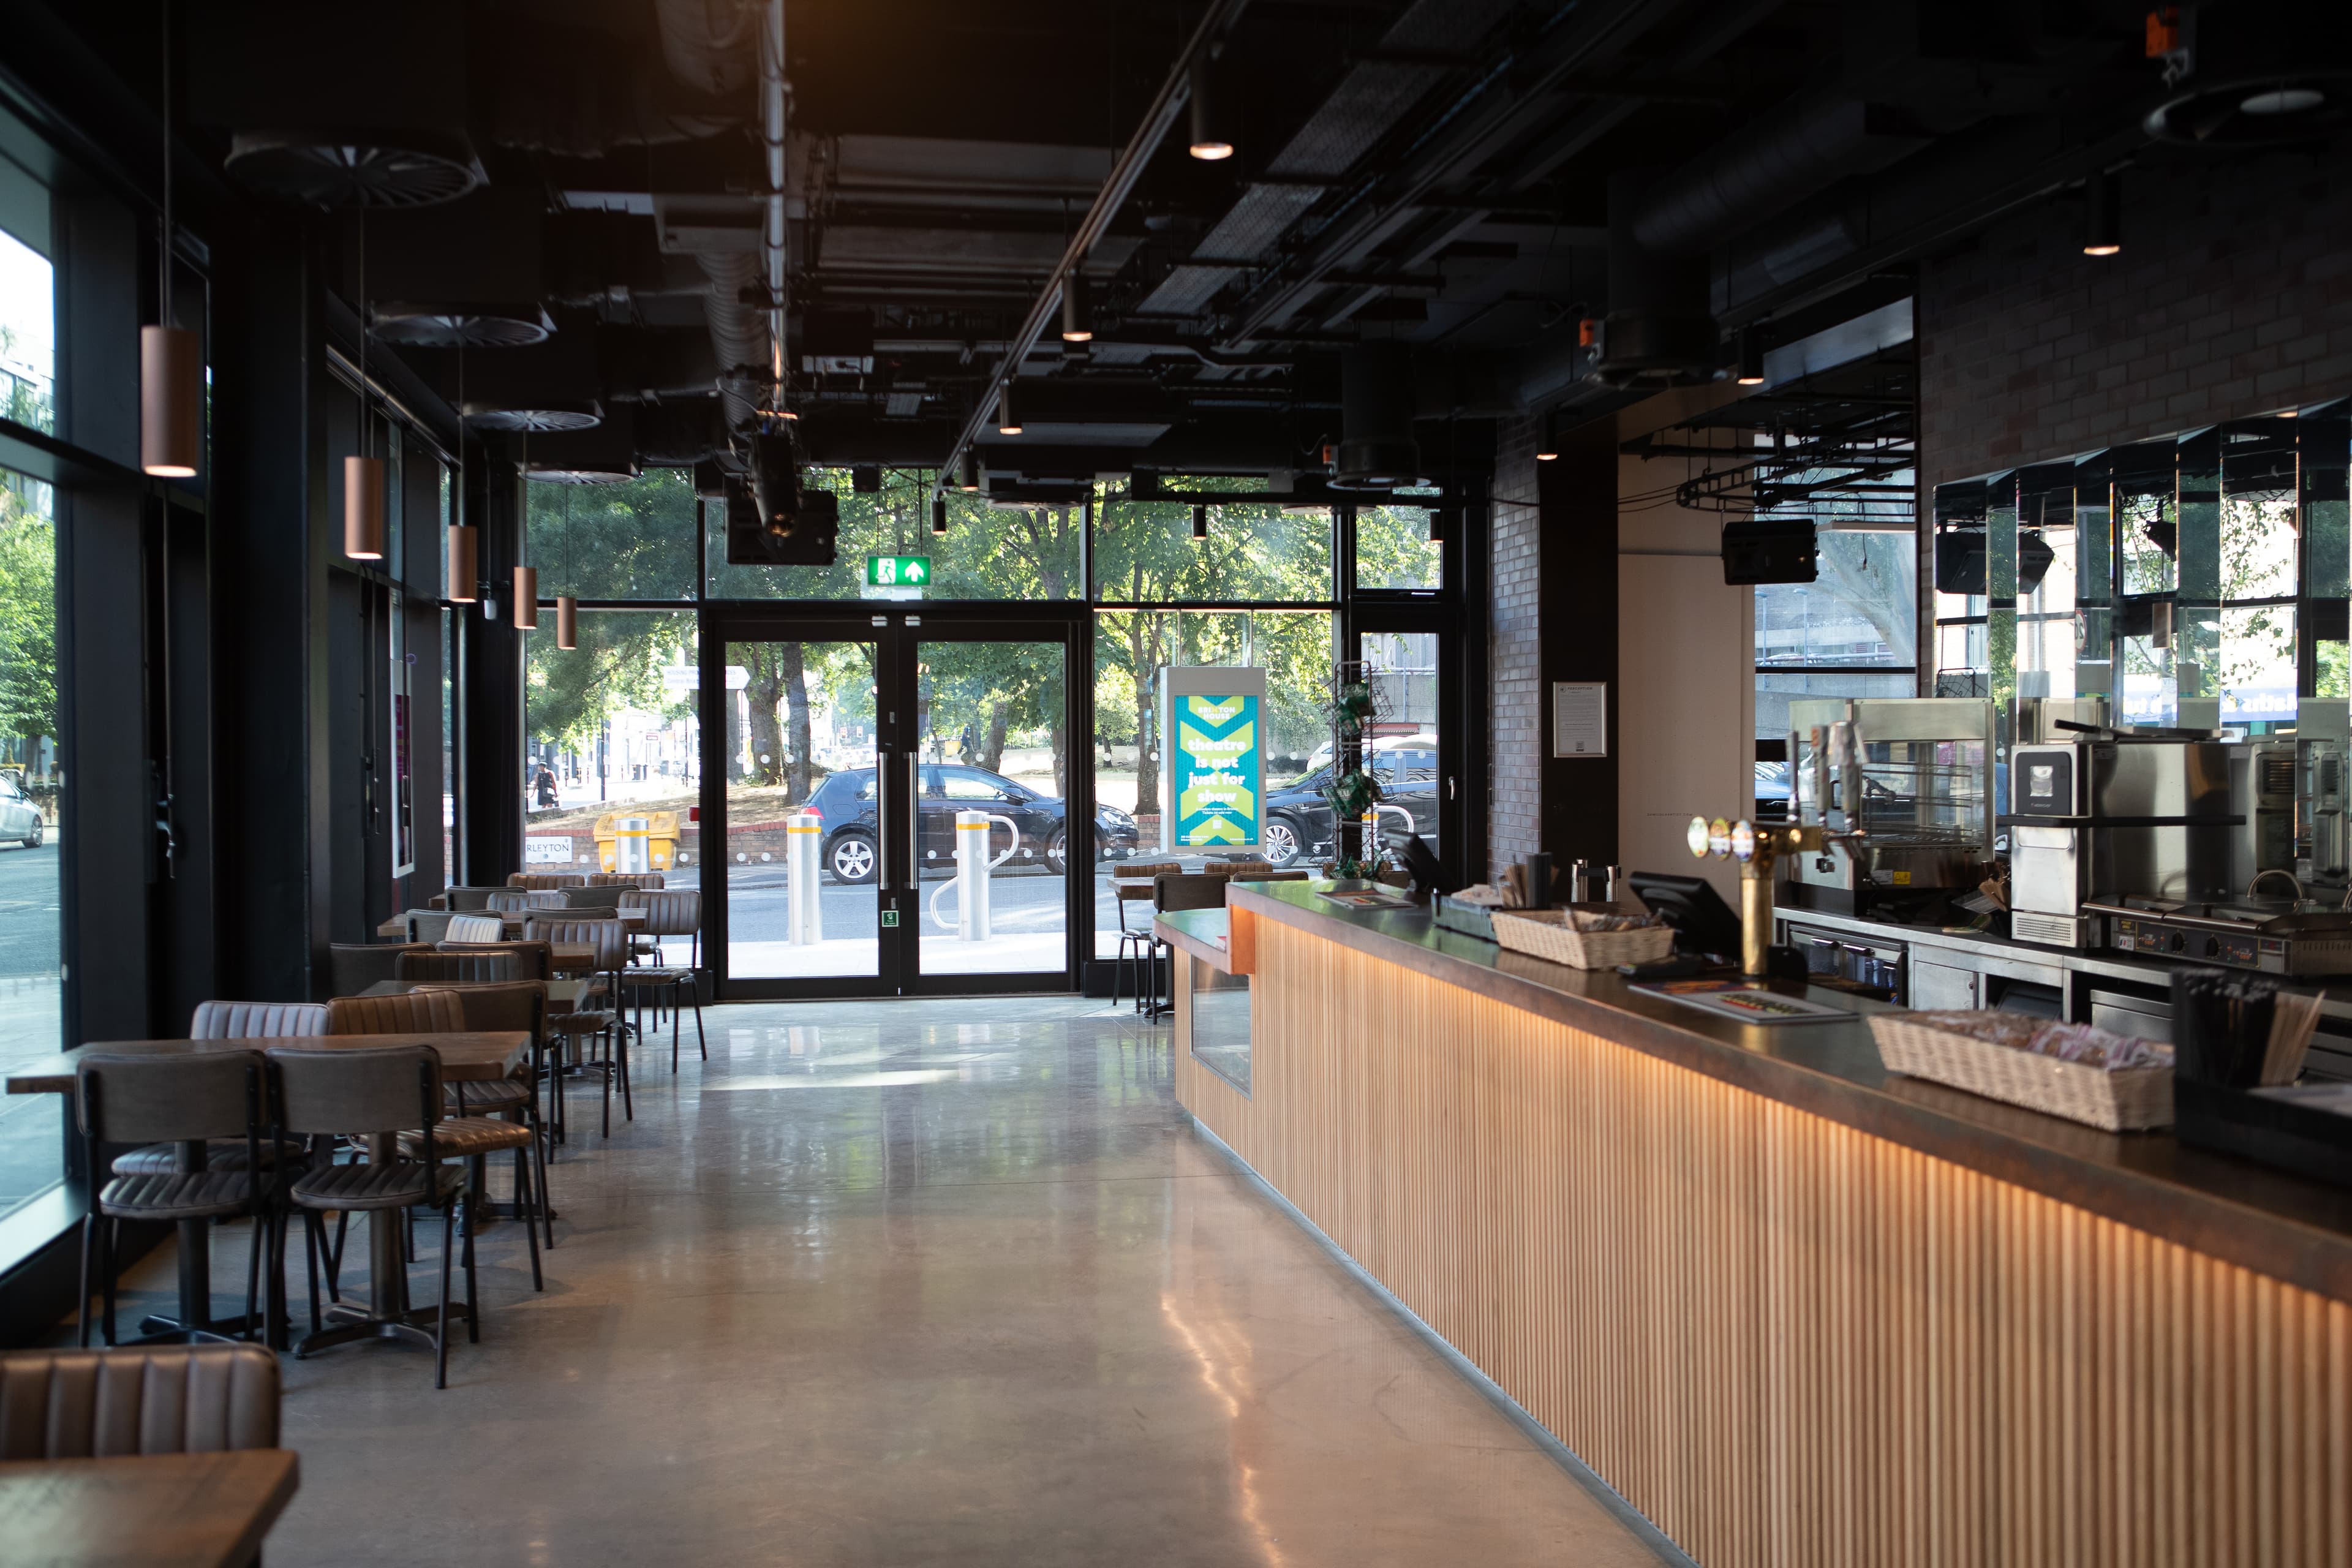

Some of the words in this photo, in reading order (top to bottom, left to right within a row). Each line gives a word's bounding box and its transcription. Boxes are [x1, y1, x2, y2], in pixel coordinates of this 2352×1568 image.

[1188, 738, 1246, 751] theatre
[1195, 755, 1208, 768] is
[1212, 756, 1239, 768] not
[1188, 771, 1218, 789] just
[1221, 772, 1246, 785] for
[1197, 789, 1237, 802] show
